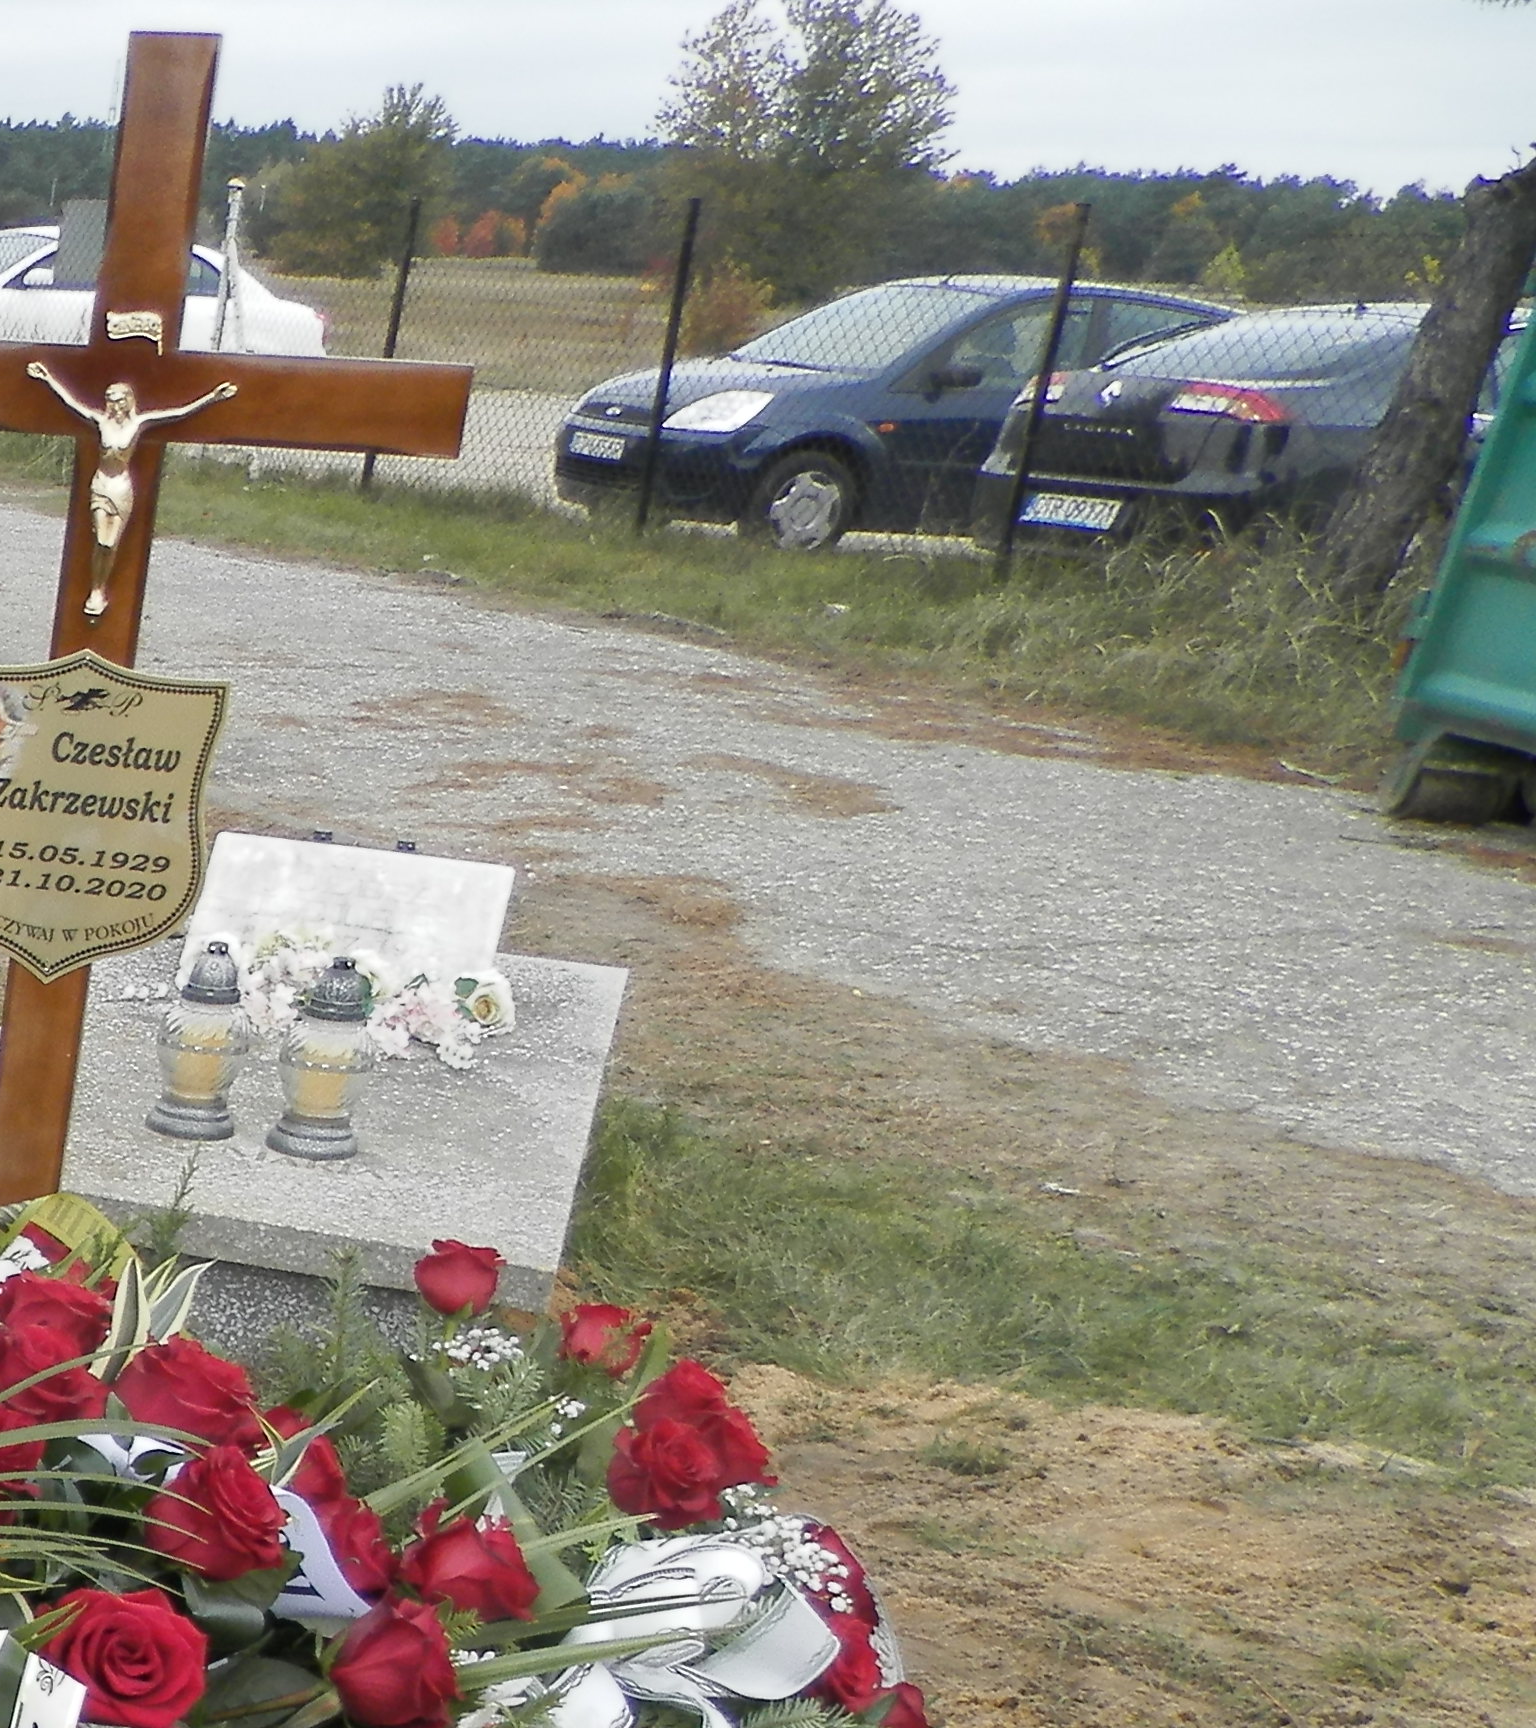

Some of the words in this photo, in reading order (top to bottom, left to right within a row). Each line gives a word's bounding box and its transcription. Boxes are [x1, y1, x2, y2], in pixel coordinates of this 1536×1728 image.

[51, 730, 182, 774] Czesław
[62, 927, 79, 942] W
[84, 912, 156, 943] POKOJU
